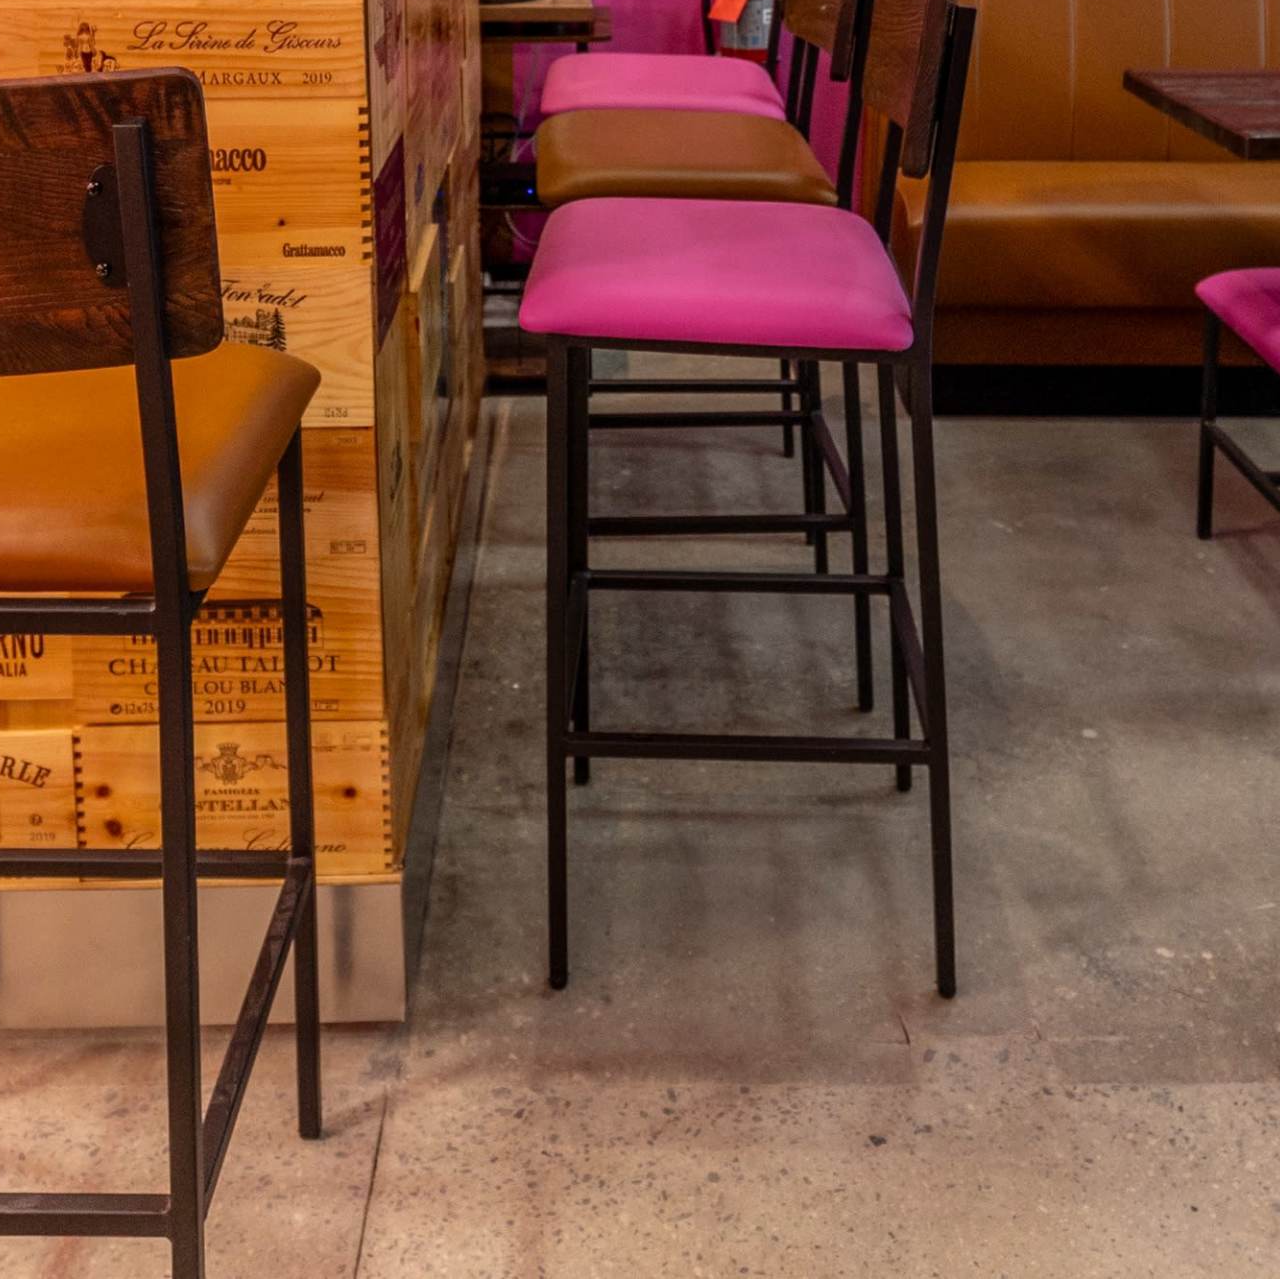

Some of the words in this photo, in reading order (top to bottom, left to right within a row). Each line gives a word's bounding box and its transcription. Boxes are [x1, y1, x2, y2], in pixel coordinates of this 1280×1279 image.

[127, 20, 167, 51] La
[233, 28, 257, 50] de
[263, 19, 342, 54] Giscours
[302, 72, 333, 85] 2019
[282, 242, 346, 258] Grattamacco
[240, 654, 342, 673] TALOT
[204, 699, 246, 715] 2019
[29, 831, 57, 842] 2019
